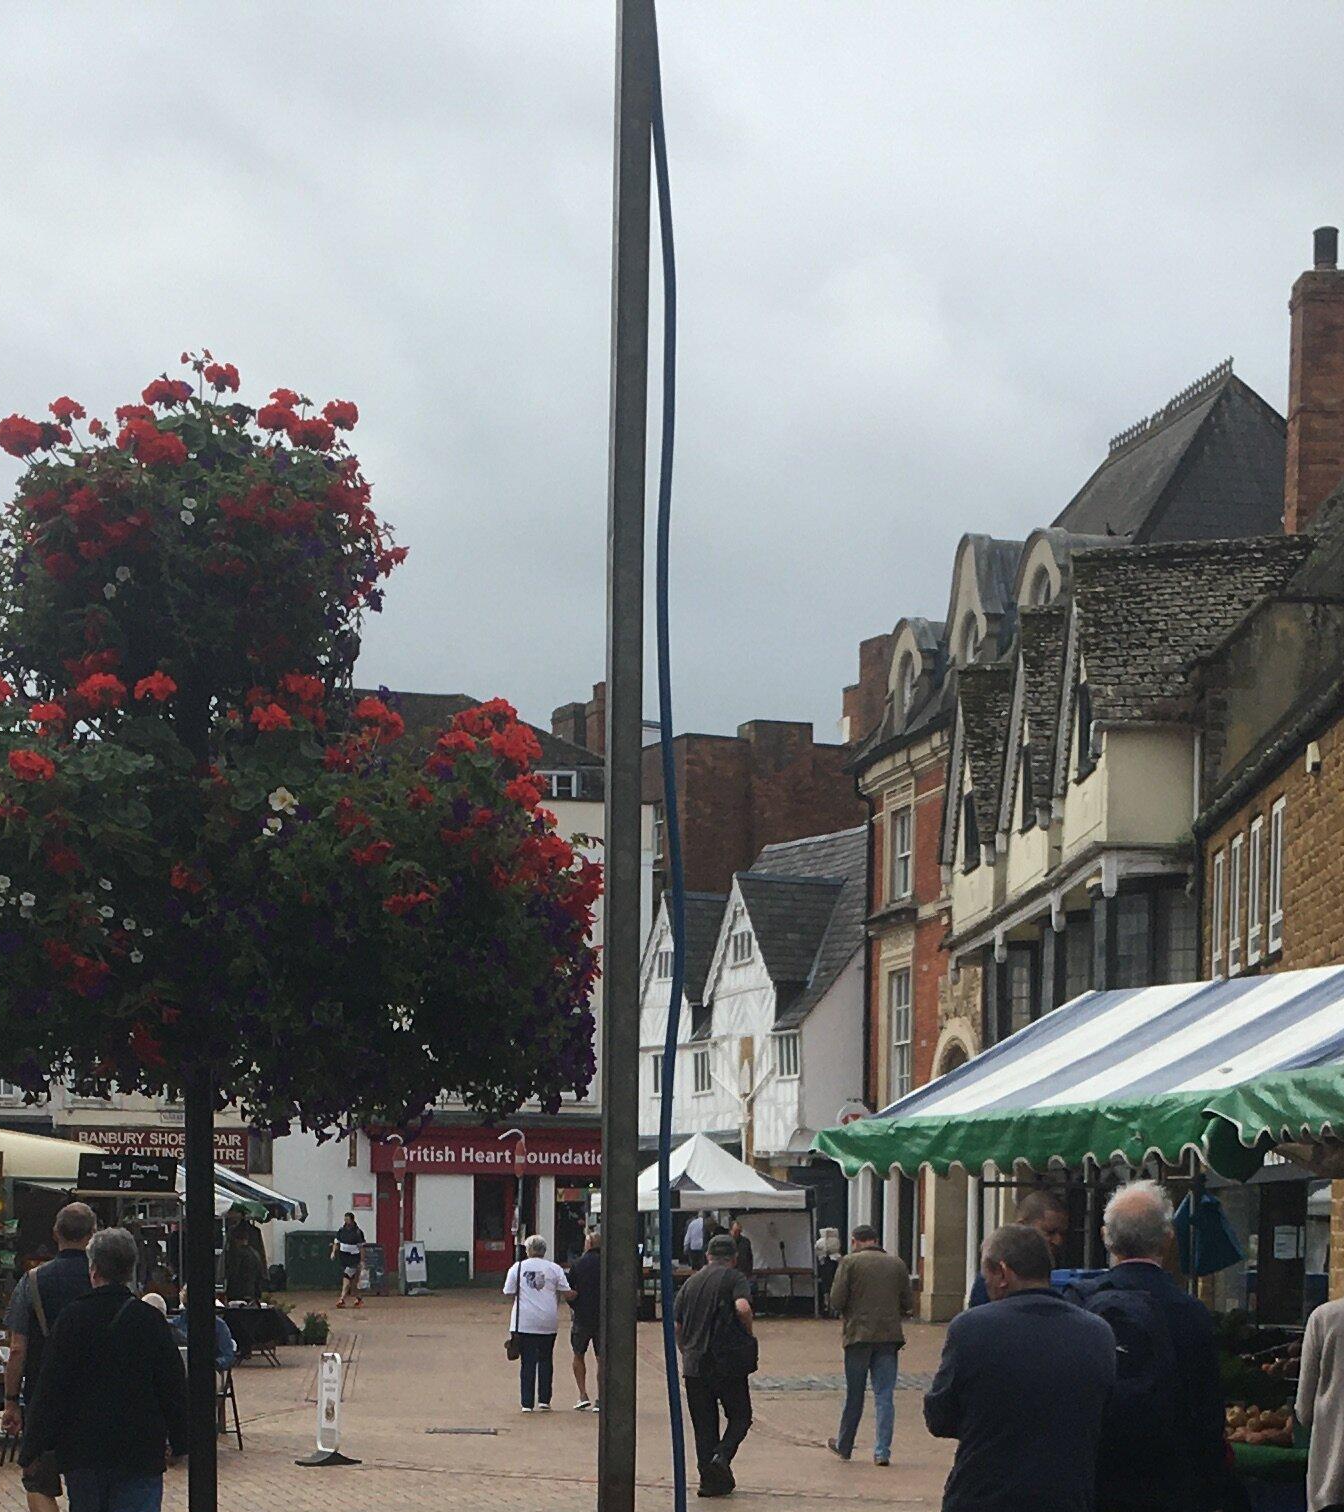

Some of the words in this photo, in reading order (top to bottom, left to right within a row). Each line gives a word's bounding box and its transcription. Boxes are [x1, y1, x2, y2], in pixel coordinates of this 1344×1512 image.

[78, 1132, 145, 1144] BANBURY
[149, 1132, 185, 1145] SHOE
[461, 1147, 512, 1163] Heart
[527, 1148, 602, 1165] oundati
